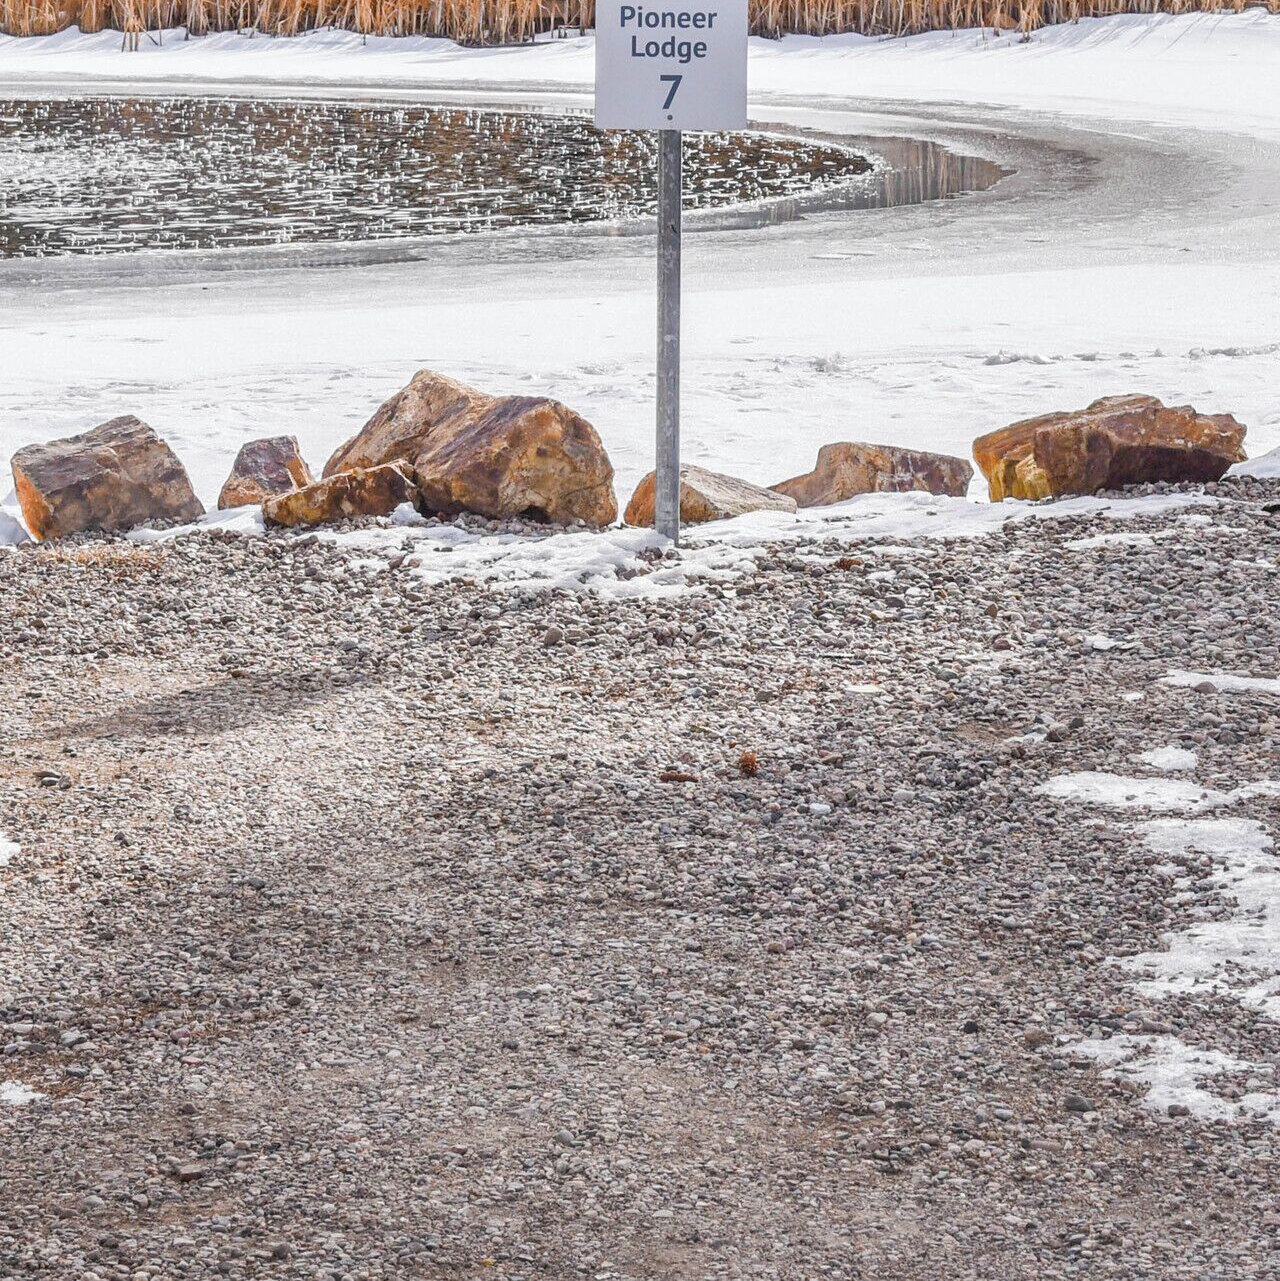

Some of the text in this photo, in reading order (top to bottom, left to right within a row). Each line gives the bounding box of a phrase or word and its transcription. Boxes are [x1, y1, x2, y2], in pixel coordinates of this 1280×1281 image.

[620, 5, 718, 29] Pioneer
[631, 35, 707, 64] Lodge
[660, 74, 683, 110] 7
